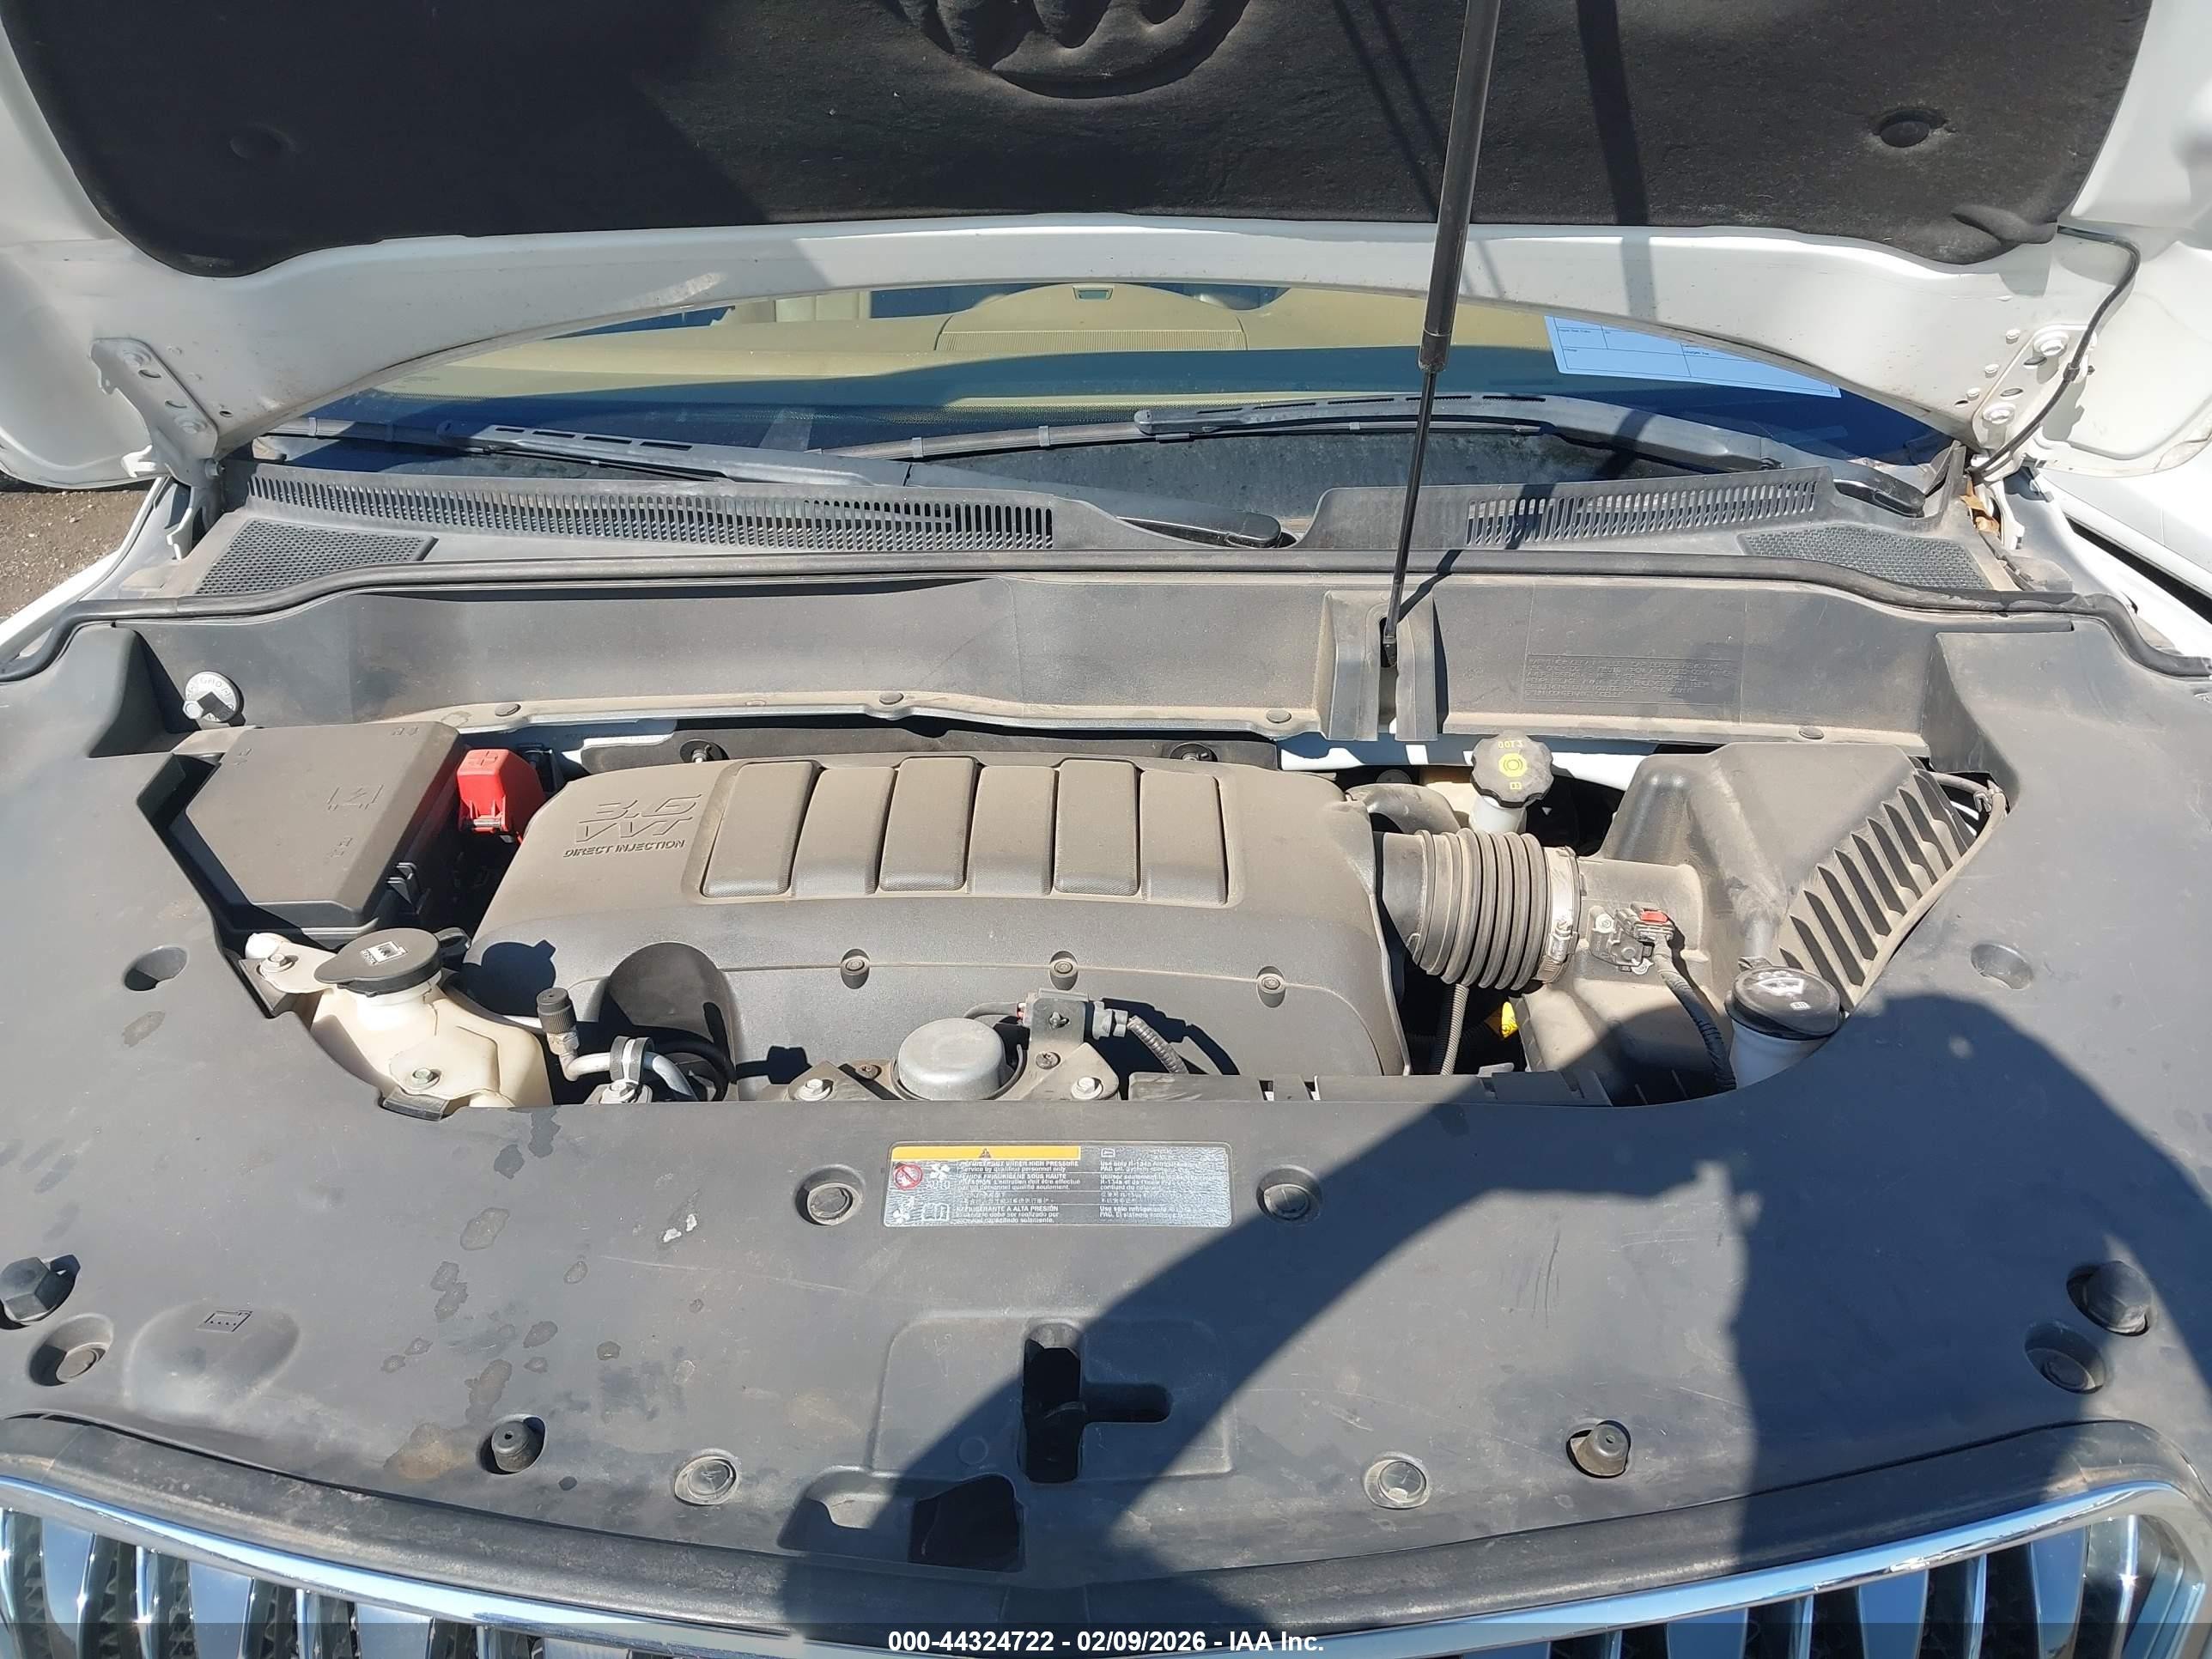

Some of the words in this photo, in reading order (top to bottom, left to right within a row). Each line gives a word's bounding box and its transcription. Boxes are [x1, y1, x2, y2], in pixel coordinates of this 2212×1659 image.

[1498, 740, 1515, 749] DOT
[578, 793, 702, 823] 3.6
[575, 817, 694, 843] VVT
[562, 845, 613, 858] DIRECT
[615, 839, 686, 854] INJECTION
